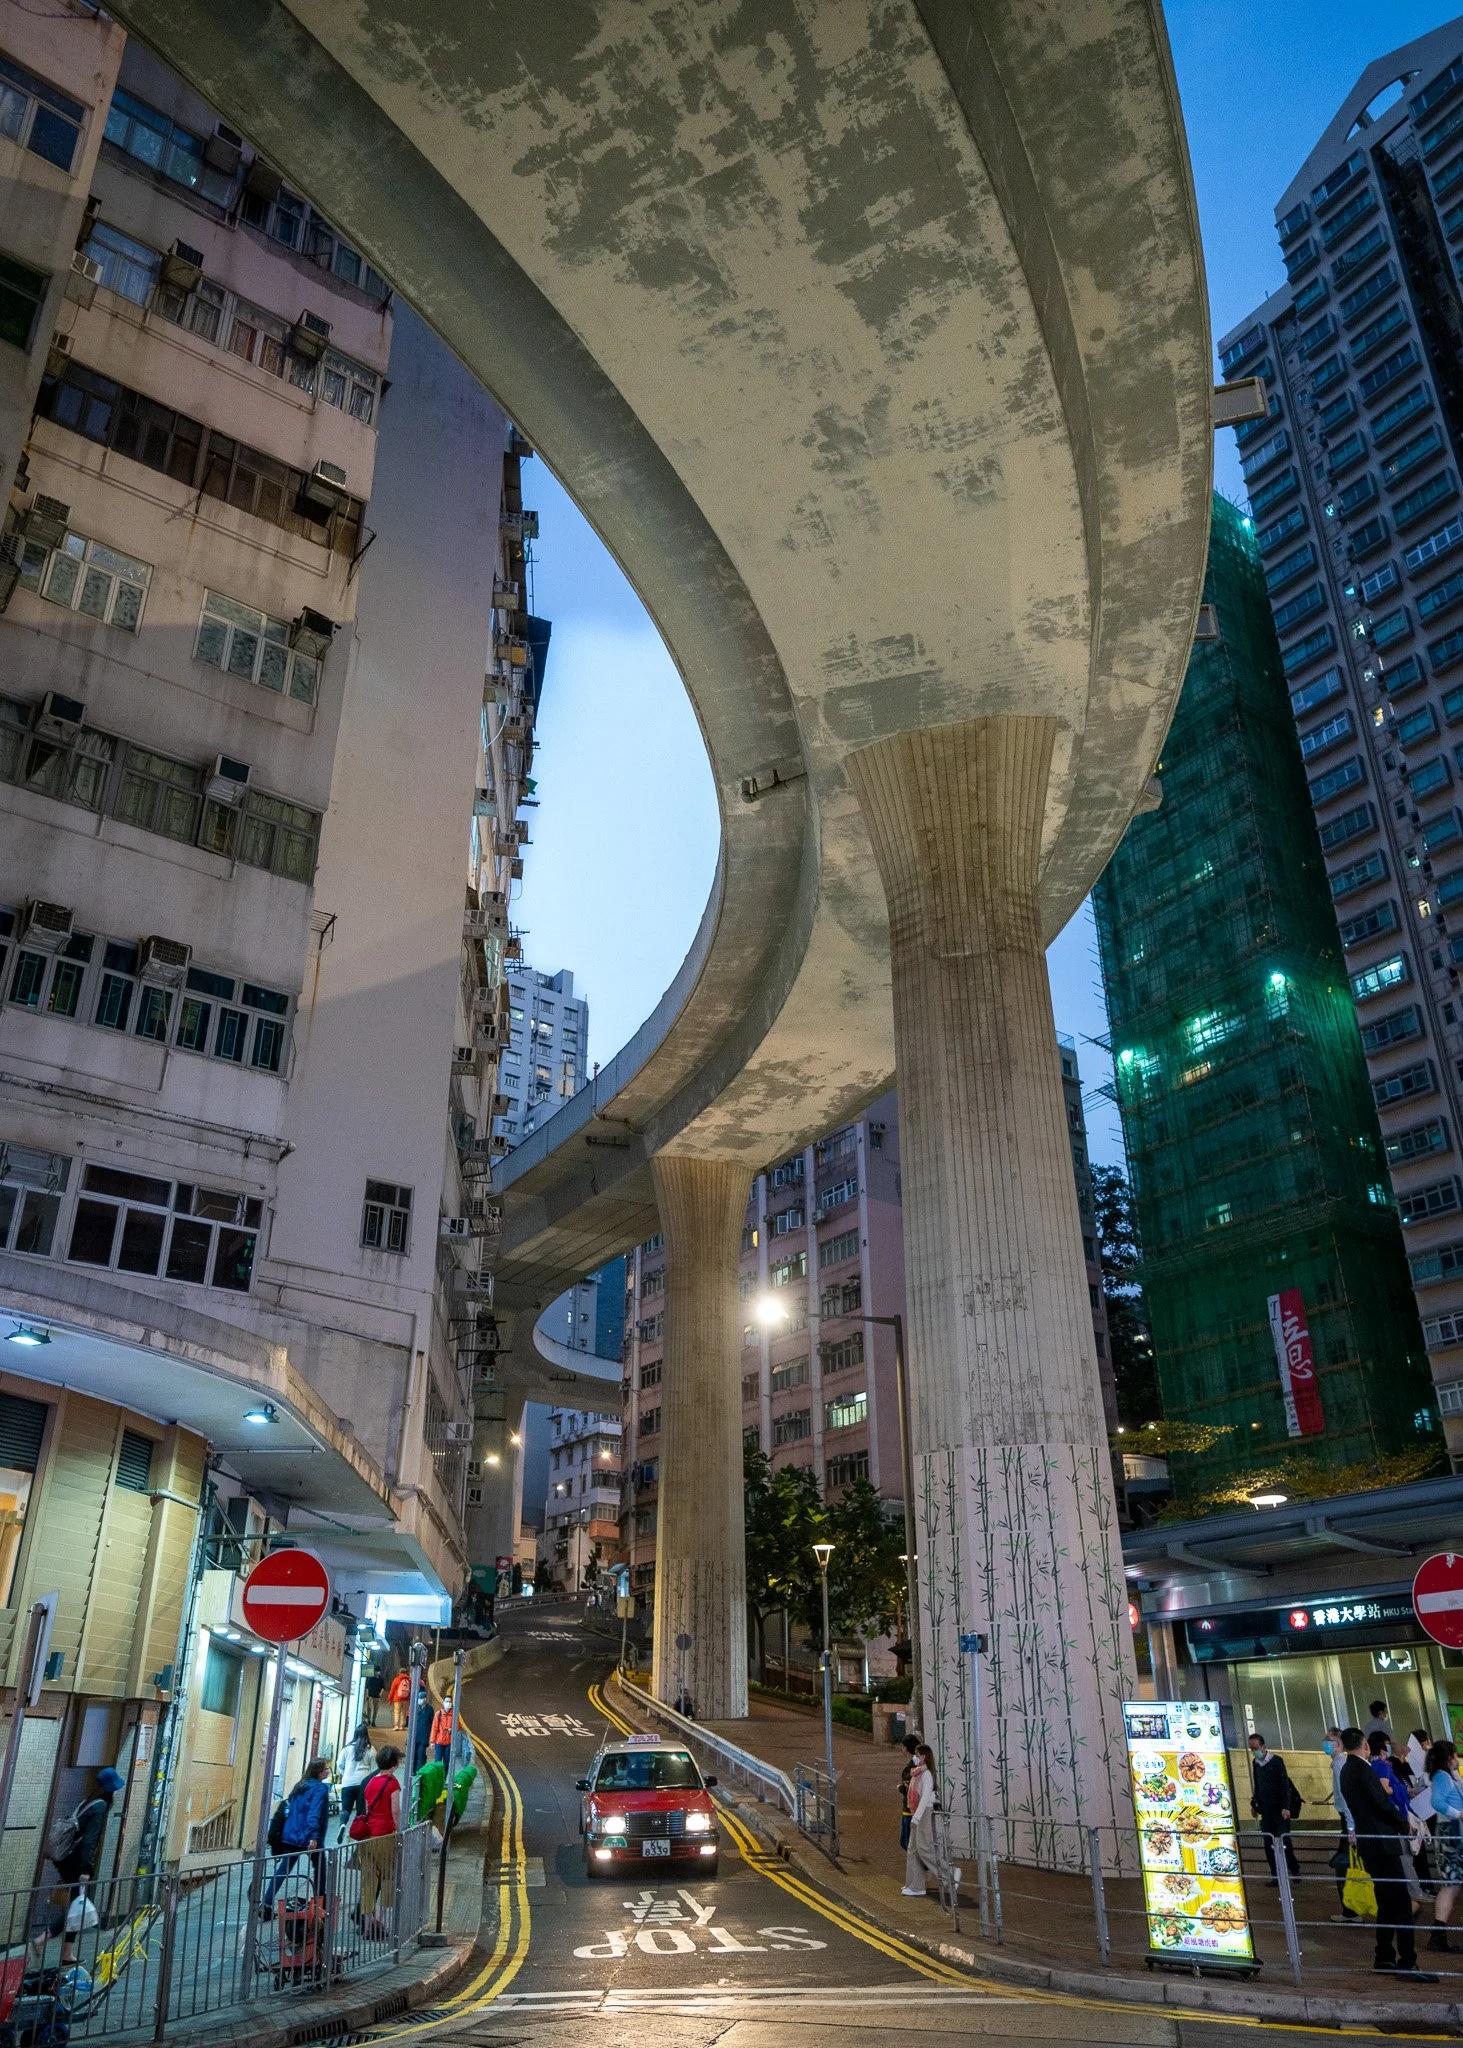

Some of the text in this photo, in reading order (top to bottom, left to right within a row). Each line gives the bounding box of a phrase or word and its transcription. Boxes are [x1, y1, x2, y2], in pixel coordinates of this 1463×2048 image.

[1312, 1603, 1381, 1626] 香港大學站
[1383, 1608, 1400, 1617] HKU
[506, 1727, 595, 1737] SLOW
[645, 1848, 668, 1856] 8339
[650, 1840, 662, 1850] KL
[622, 1889, 717, 1926] 停
[573, 1926, 828, 1959] STOP
